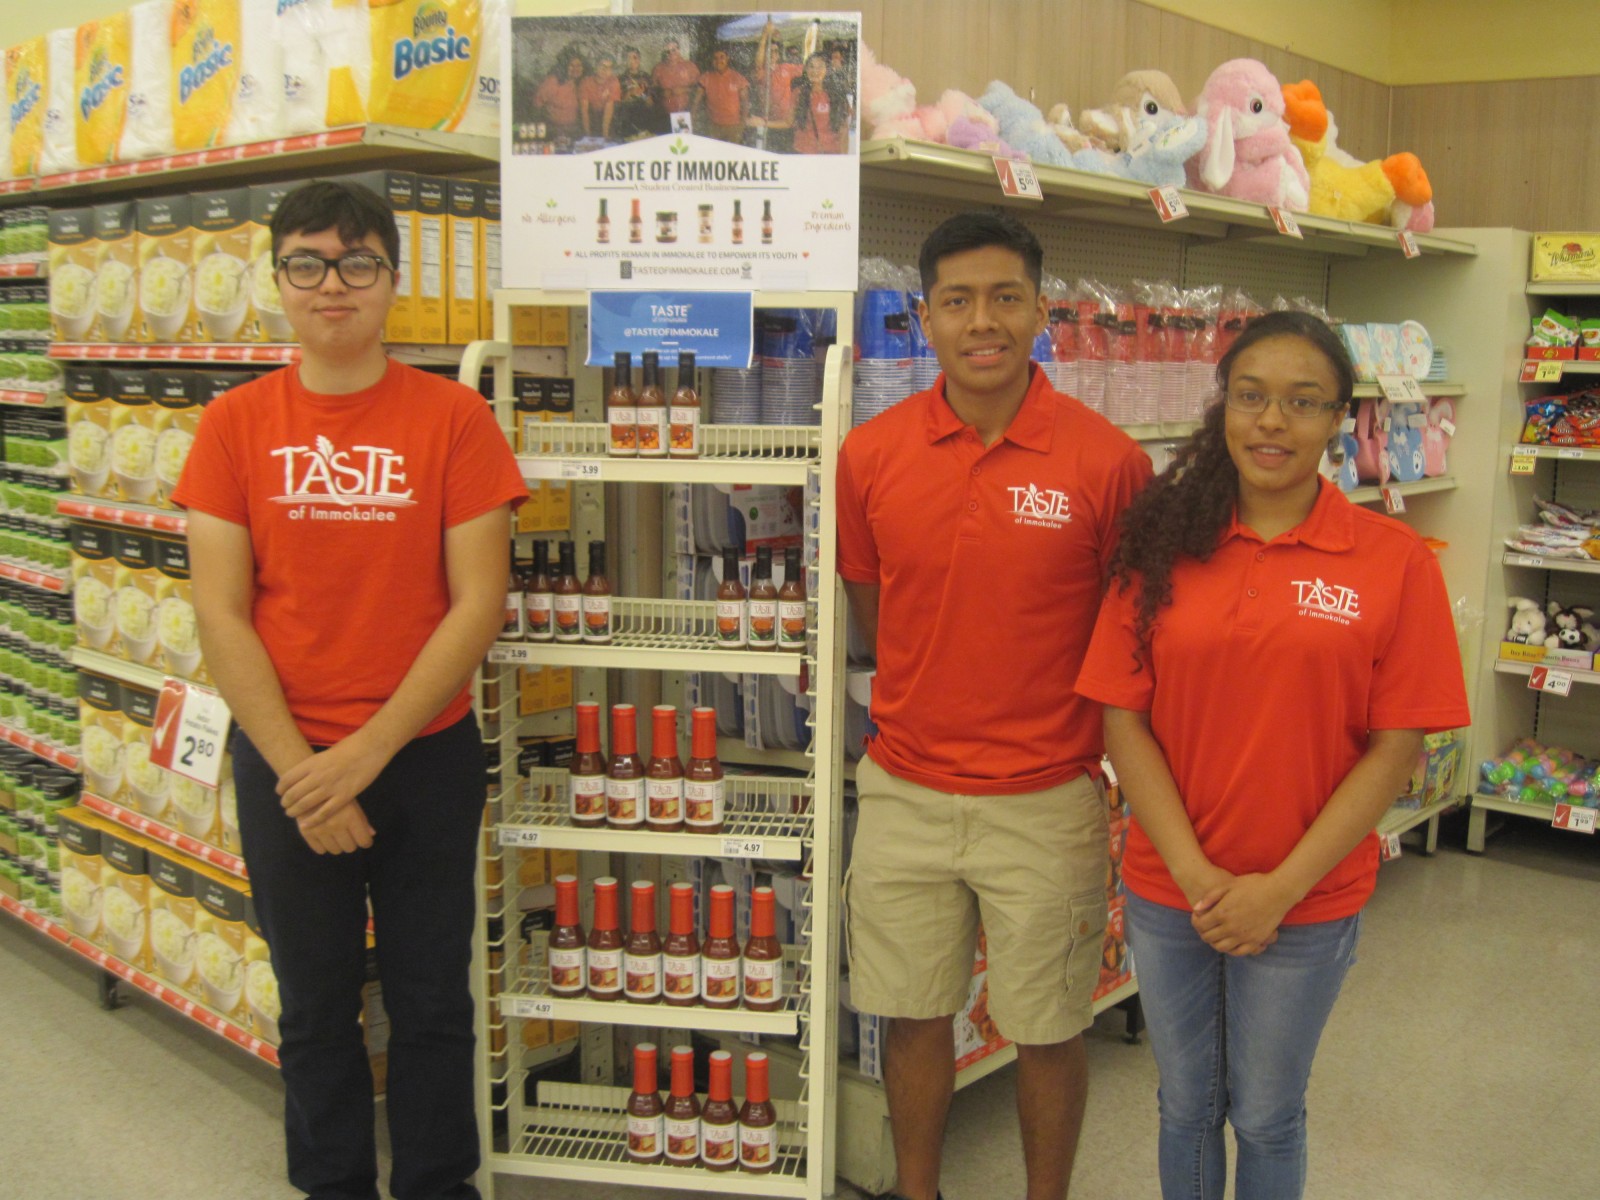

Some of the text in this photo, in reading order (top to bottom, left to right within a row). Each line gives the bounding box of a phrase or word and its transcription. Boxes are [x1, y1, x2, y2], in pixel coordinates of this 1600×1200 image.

[413, 9, 447, 37] Bounty
[394, 27, 471, 80] Basic
[593, 161, 779, 181] TASTE OF IMMOKALEE
[621, 251, 650, 259] REMAIN
[652, 251, 660, 259] IN
[661, 251, 705, 259] IMMOKALEE
[772, 252, 798, 260] YOUTH
[632, 266, 740, 275] TASTEOFIMMOKALEE.COM
[650, 305, 688, 317] TASTE
[270, 440, 414, 506] TASTE
[1006, 485, 1072, 519] TASTE
[288, 504, 397, 522] of Immokalee
[1014, 516, 1063, 530] of Immokalee
[1290, 579, 1361, 618] TASTE
[1298, 608, 1351, 626] of Immokalee
[744, 843, 760, 852] 4.97
